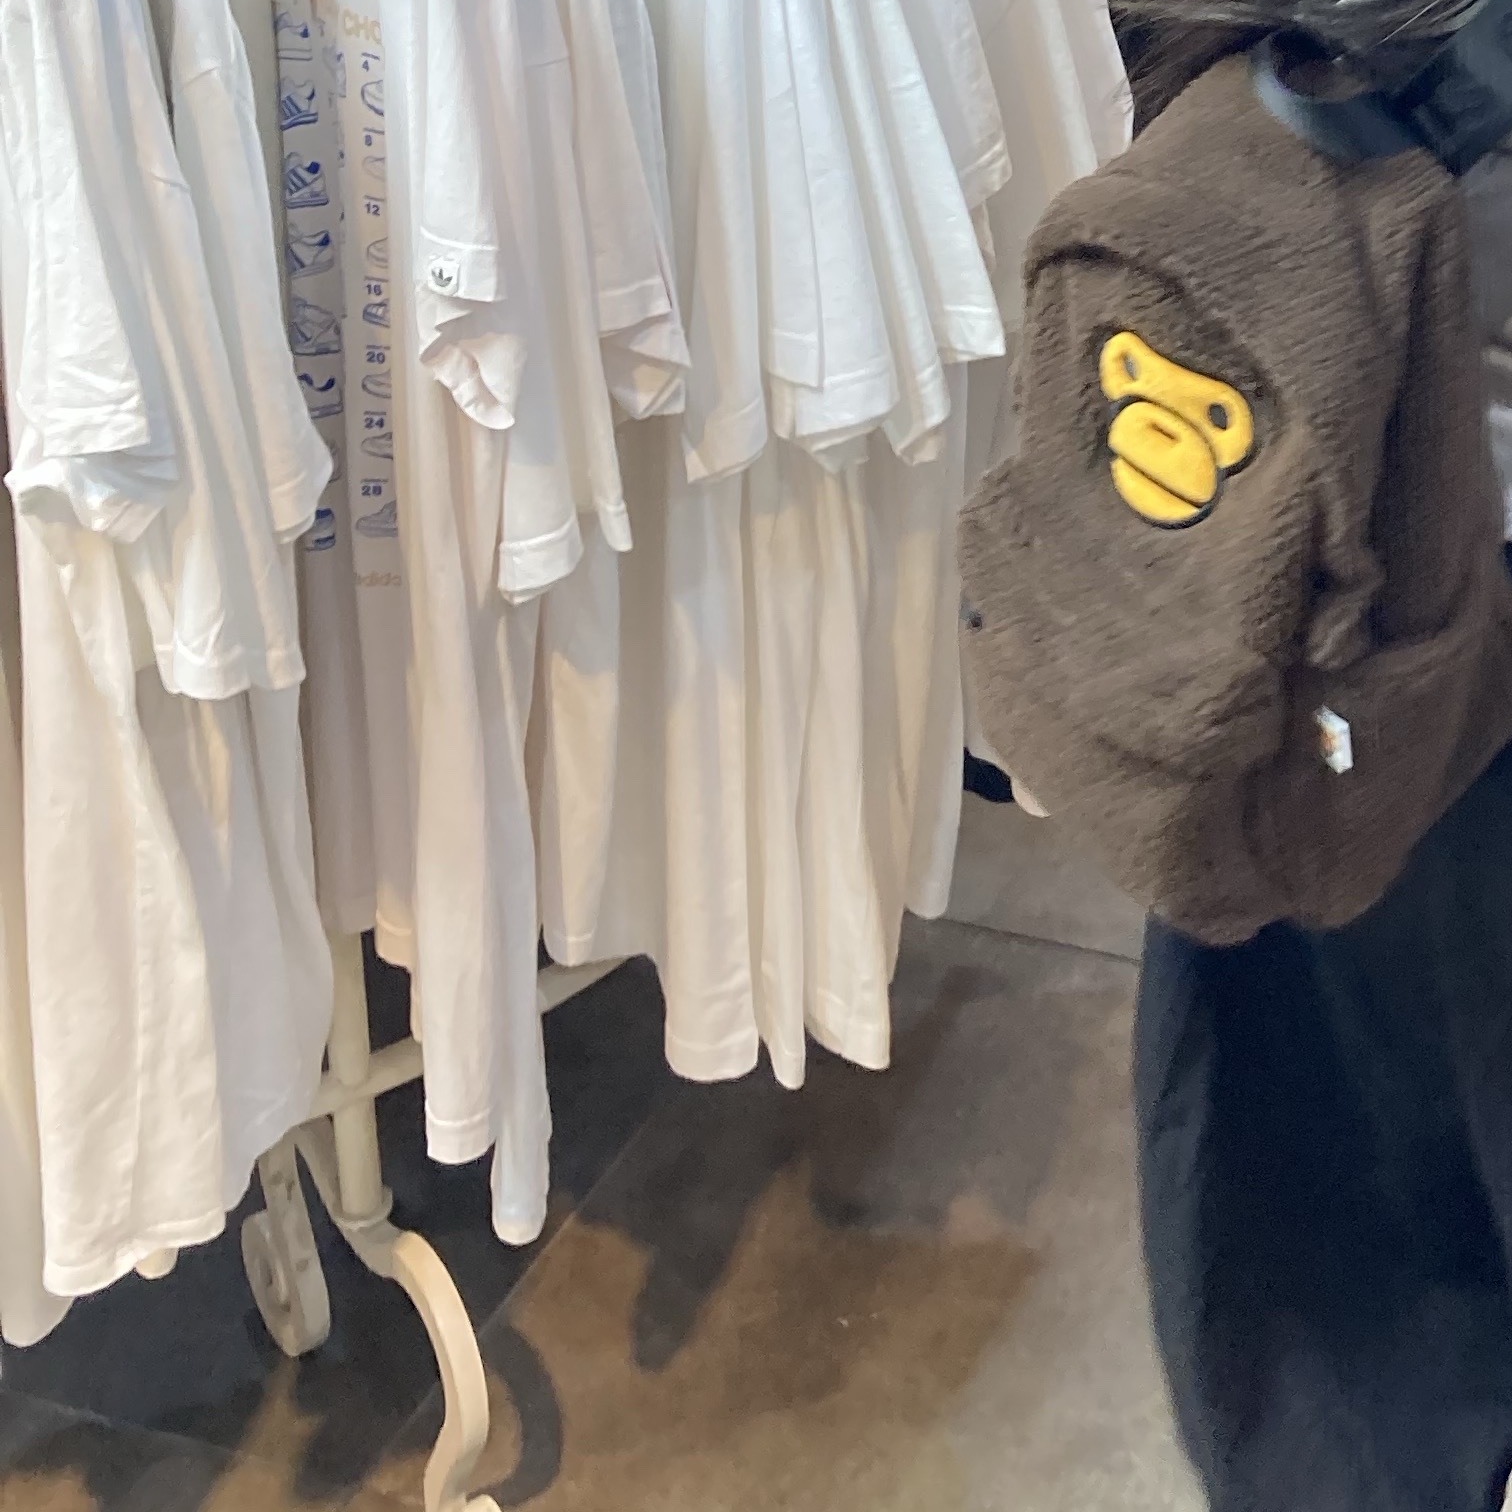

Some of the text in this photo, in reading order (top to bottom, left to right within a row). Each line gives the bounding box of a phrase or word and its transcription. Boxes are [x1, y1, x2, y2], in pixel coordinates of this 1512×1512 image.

[366, 202, 381, 216] 12
[366, 283, 382, 296] 16
[366, 351, 386, 364] 20
[364, 417, 385, 429] 24
